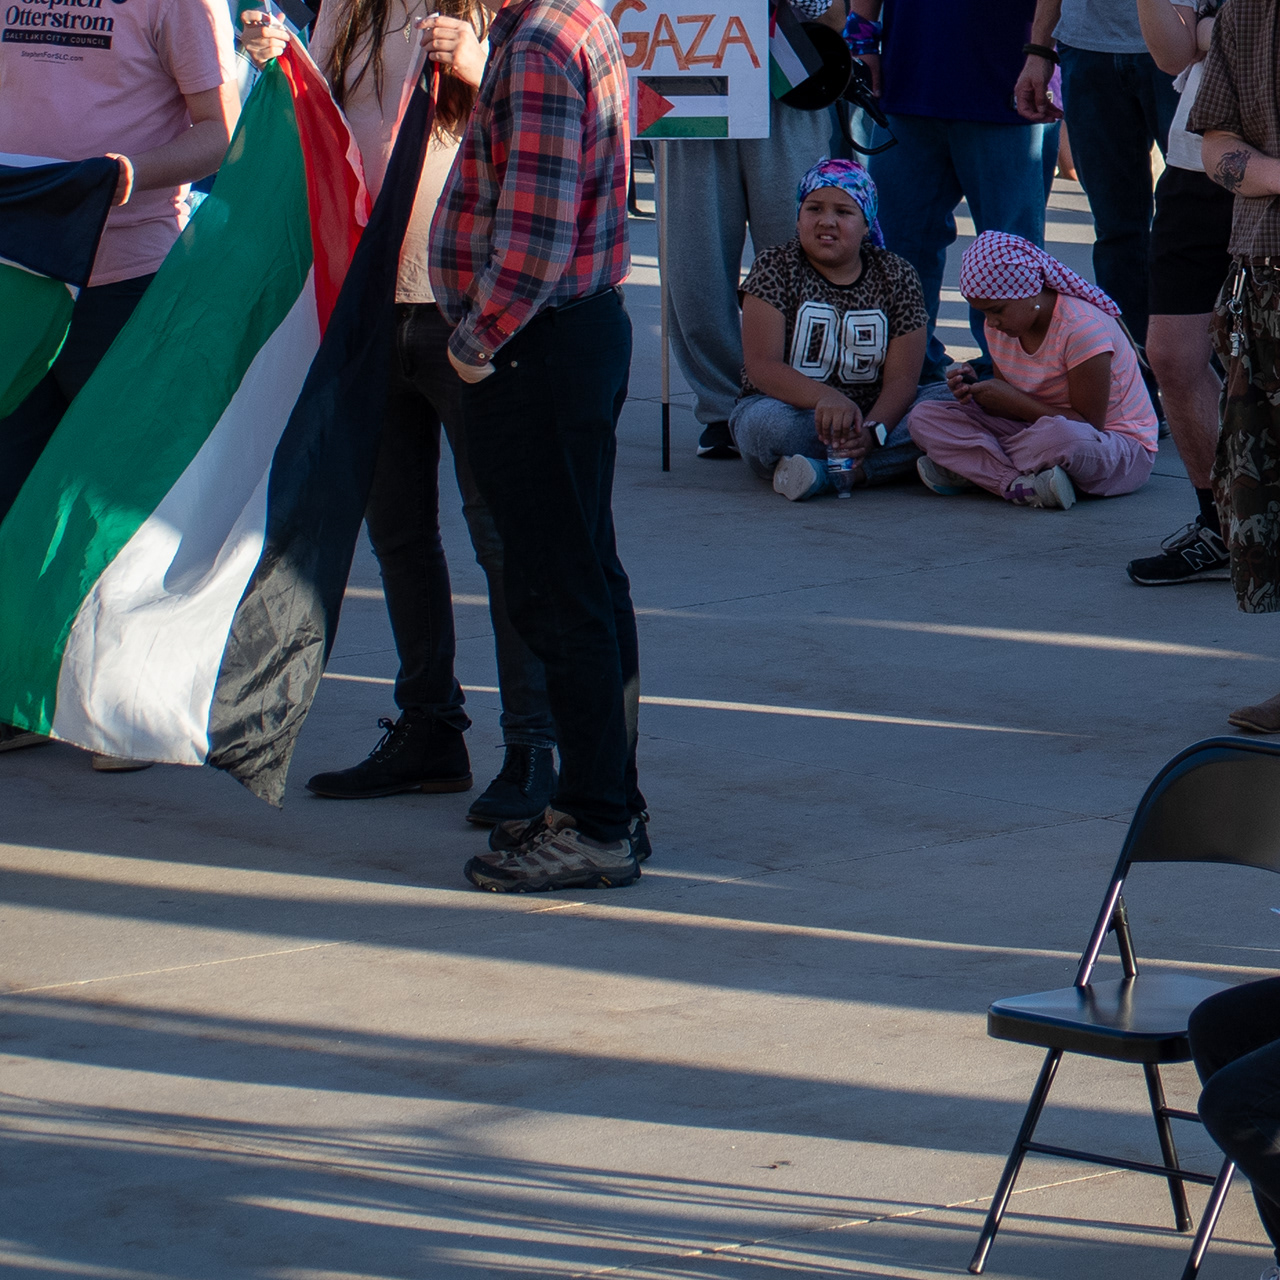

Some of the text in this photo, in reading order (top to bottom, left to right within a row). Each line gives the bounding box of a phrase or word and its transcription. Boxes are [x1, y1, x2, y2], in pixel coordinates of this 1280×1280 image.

[6, 5, 115, 32] Otterstrom
[5, 32, 105, 46] SALT LAKE CITY COUNCIL
[21, 50, 84, 61] StephenForSLC.com
[789, 300, 888, 384] 08
